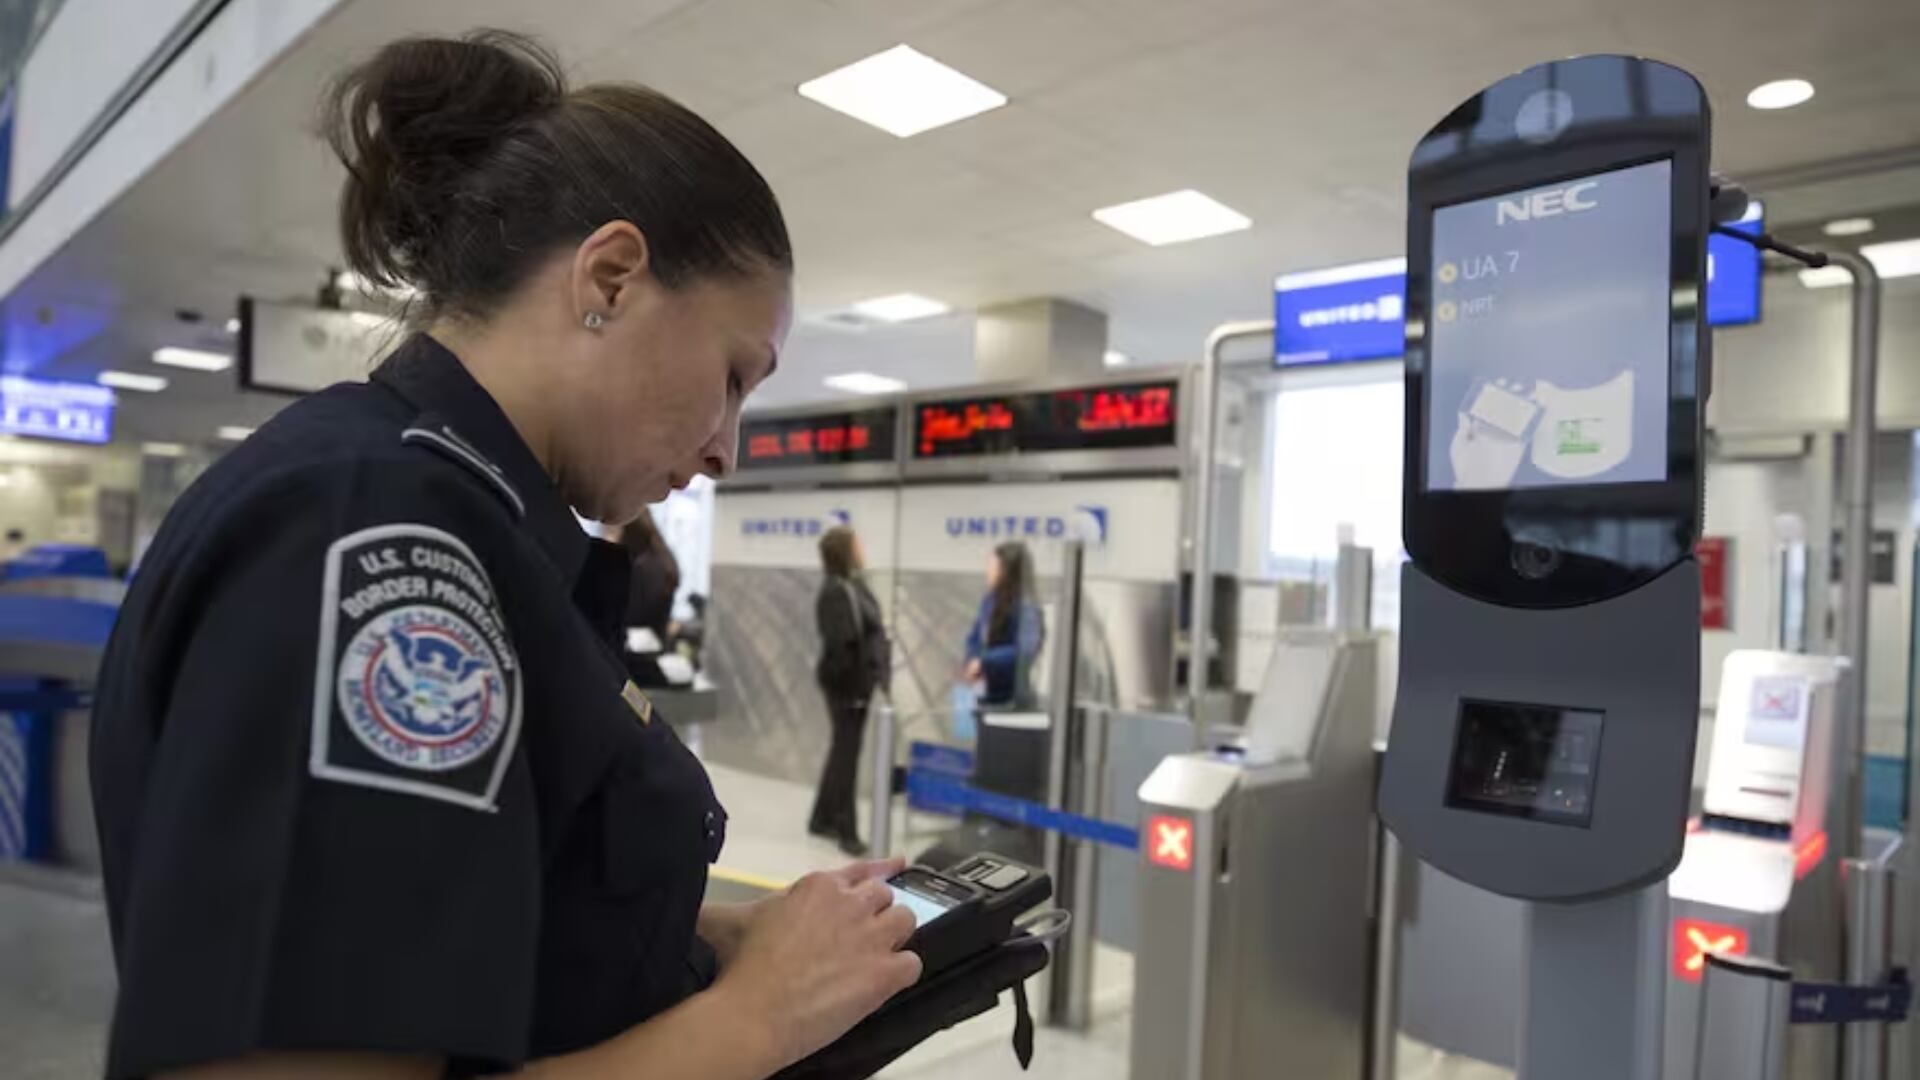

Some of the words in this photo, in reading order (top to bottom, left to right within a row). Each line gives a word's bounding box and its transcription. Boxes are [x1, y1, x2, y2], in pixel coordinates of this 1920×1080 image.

[1496, 182, 1598, 226] NEC
[1462, 255, 1498, 280] UA
[1505, 251, 1520, 273] 7
[1462, 295, 1494, 315] NRT
[741, 518, 821, 537] UNITED
[946, 516, 1065, 538] UNITED
[359, 547, 405, 575] U.S.
[341, 575, 427, 619] BORDER
[433, 579, 515, 671] PROTECTION
[345, 679, 420, 763] HOMELAND
[430, 716, 501, 765] SECURITY
